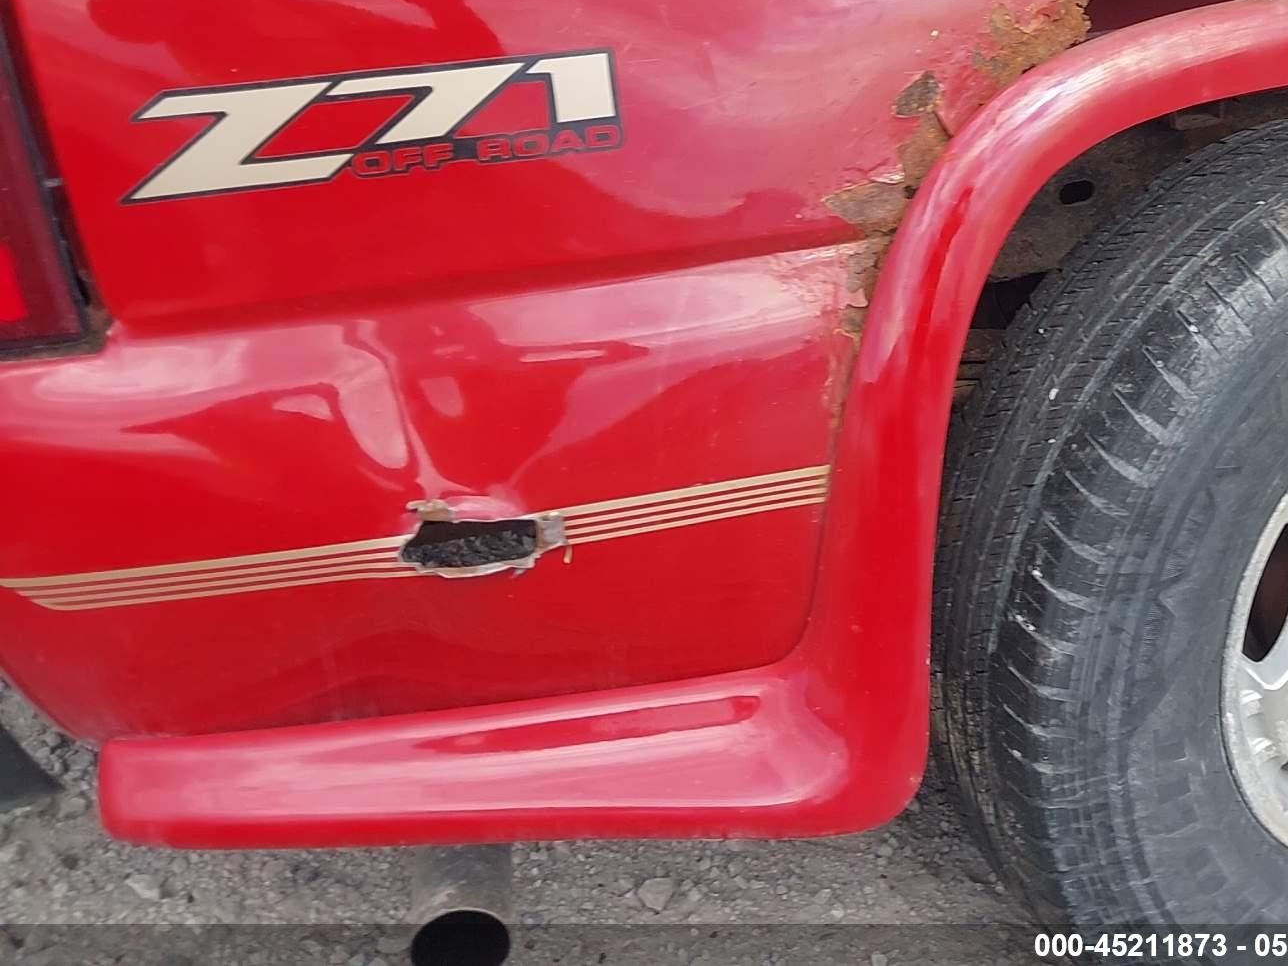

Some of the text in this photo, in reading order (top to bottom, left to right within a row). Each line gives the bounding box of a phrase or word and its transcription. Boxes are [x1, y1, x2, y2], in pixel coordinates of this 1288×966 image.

[123, 50, 617, 202] Z71
[353, 125, 622, 176] OFF ROAD
